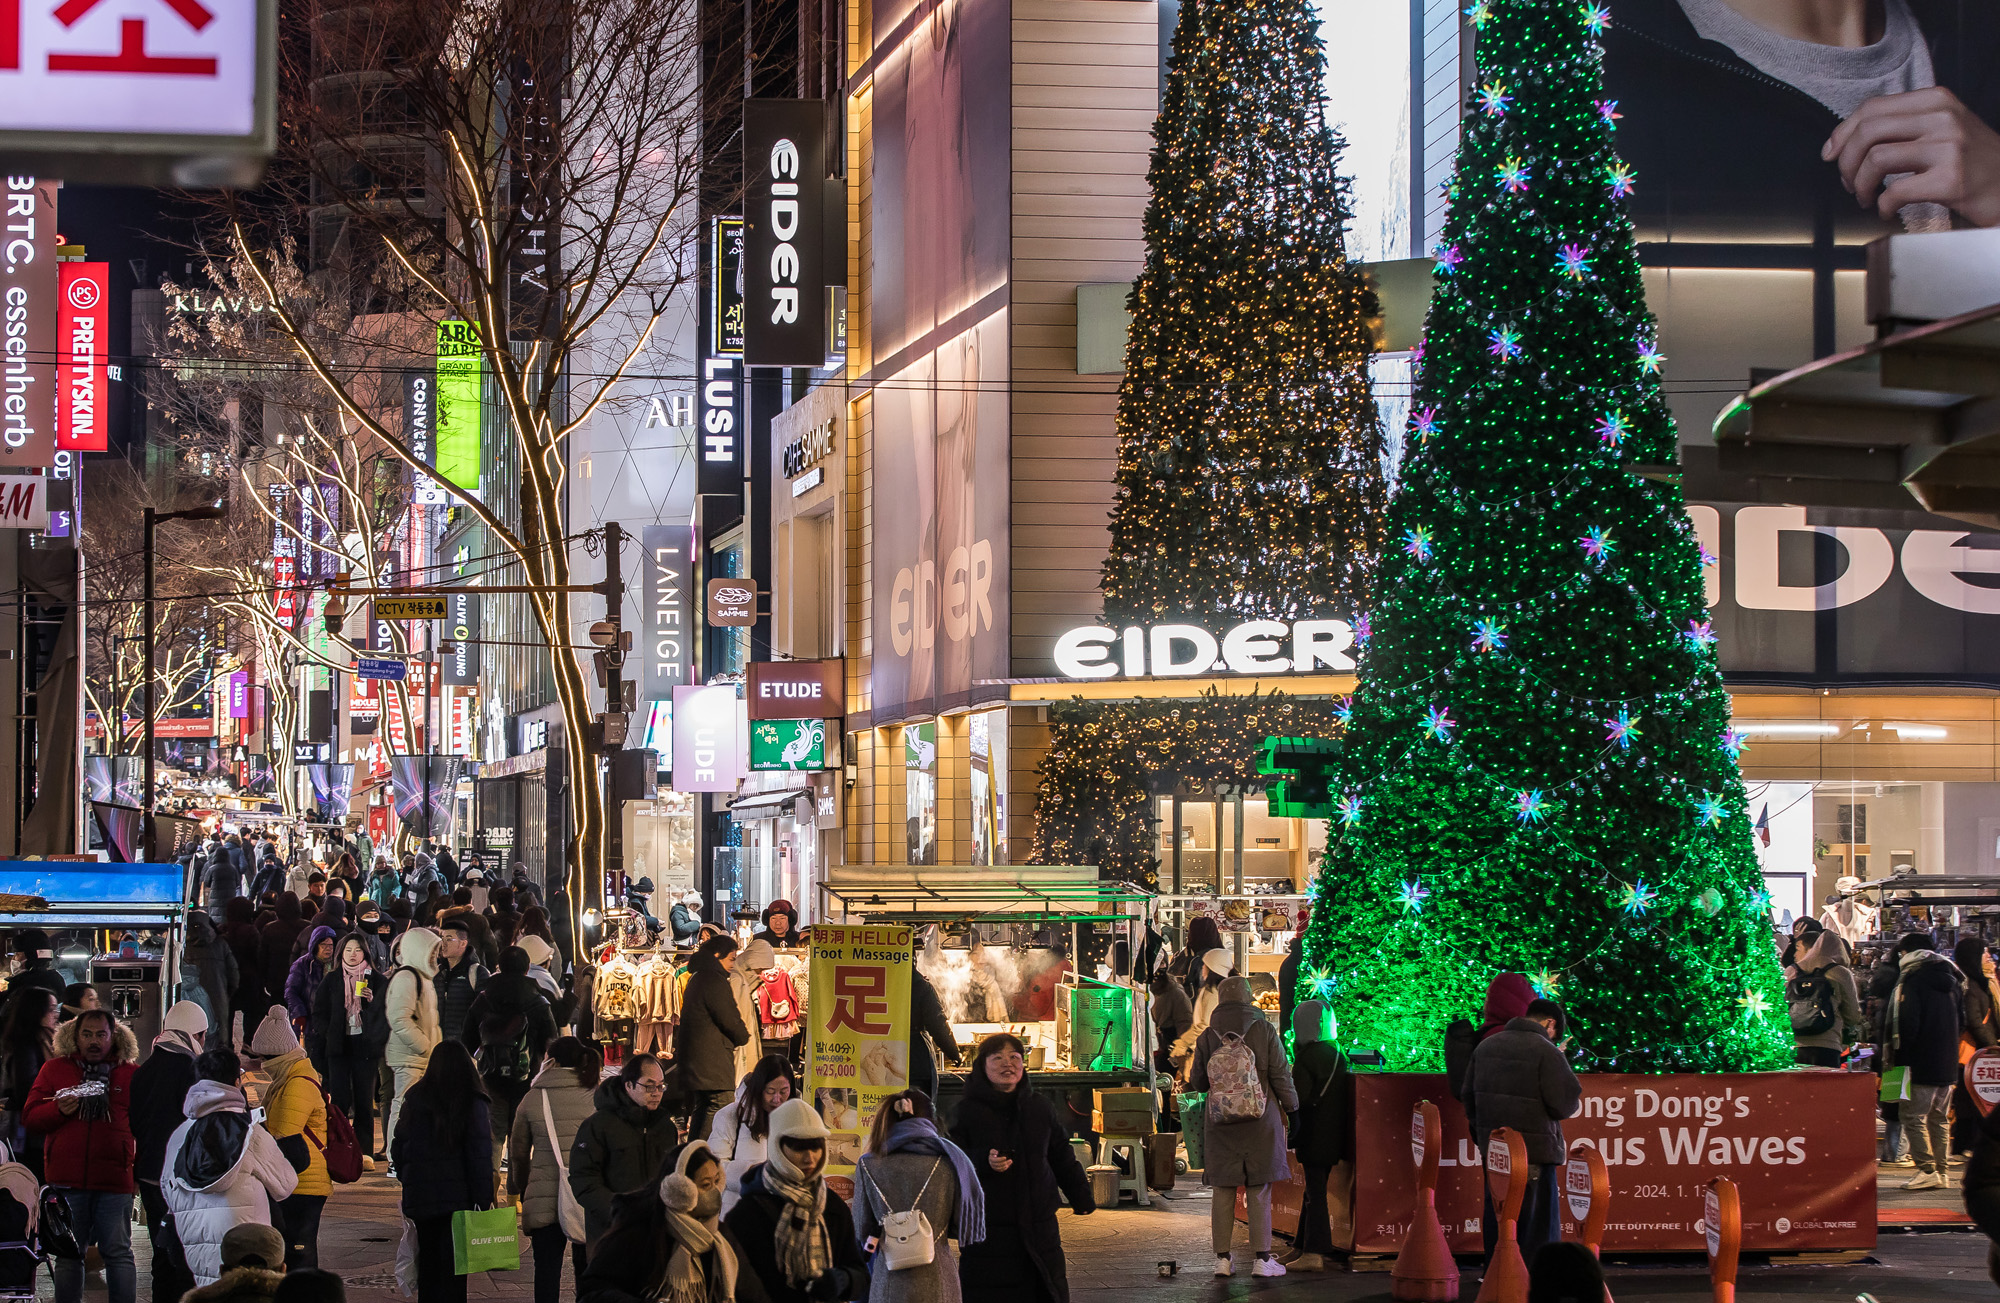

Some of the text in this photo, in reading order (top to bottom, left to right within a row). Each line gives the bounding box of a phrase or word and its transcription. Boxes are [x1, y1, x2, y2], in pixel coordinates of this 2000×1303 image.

[770, 138, 799, 325] EIDER
[5, 286, 35, 447] essenherb
[71, 316, 95, 439] PRETTYSKIN.
[438, 362, 473, 370] GRAND
[705, 358, 733, 462] LUSH
[376, 602, 434, 615] CCTV 작동중
[656, 547, 680, 678] LANEIGE
[890, 539, 993, 657] EIDER
[456, 594, 467, 677] OLIVE YOUNG
[1053, 619, 1357, 678] EIDER
[760, 682, 822, 698] ETUDE
[813, 929, 910, 946] 明洞 HELLO
[813, 947, 910, 964] Foot Massage
[825, 965, 892, 1036] 足
[815, 1063, 856, 1079] ₩25,000
[1635, 1088, 1750, 1127] Dong's
[1659, 1127, 1807, 1166] Waves
[1634, 1185, 1671, 1198] 2024.
[1677, 1185, 1688, 1198] 1.
[471, 1235, 515, 1246] OLIVE YOUNG
